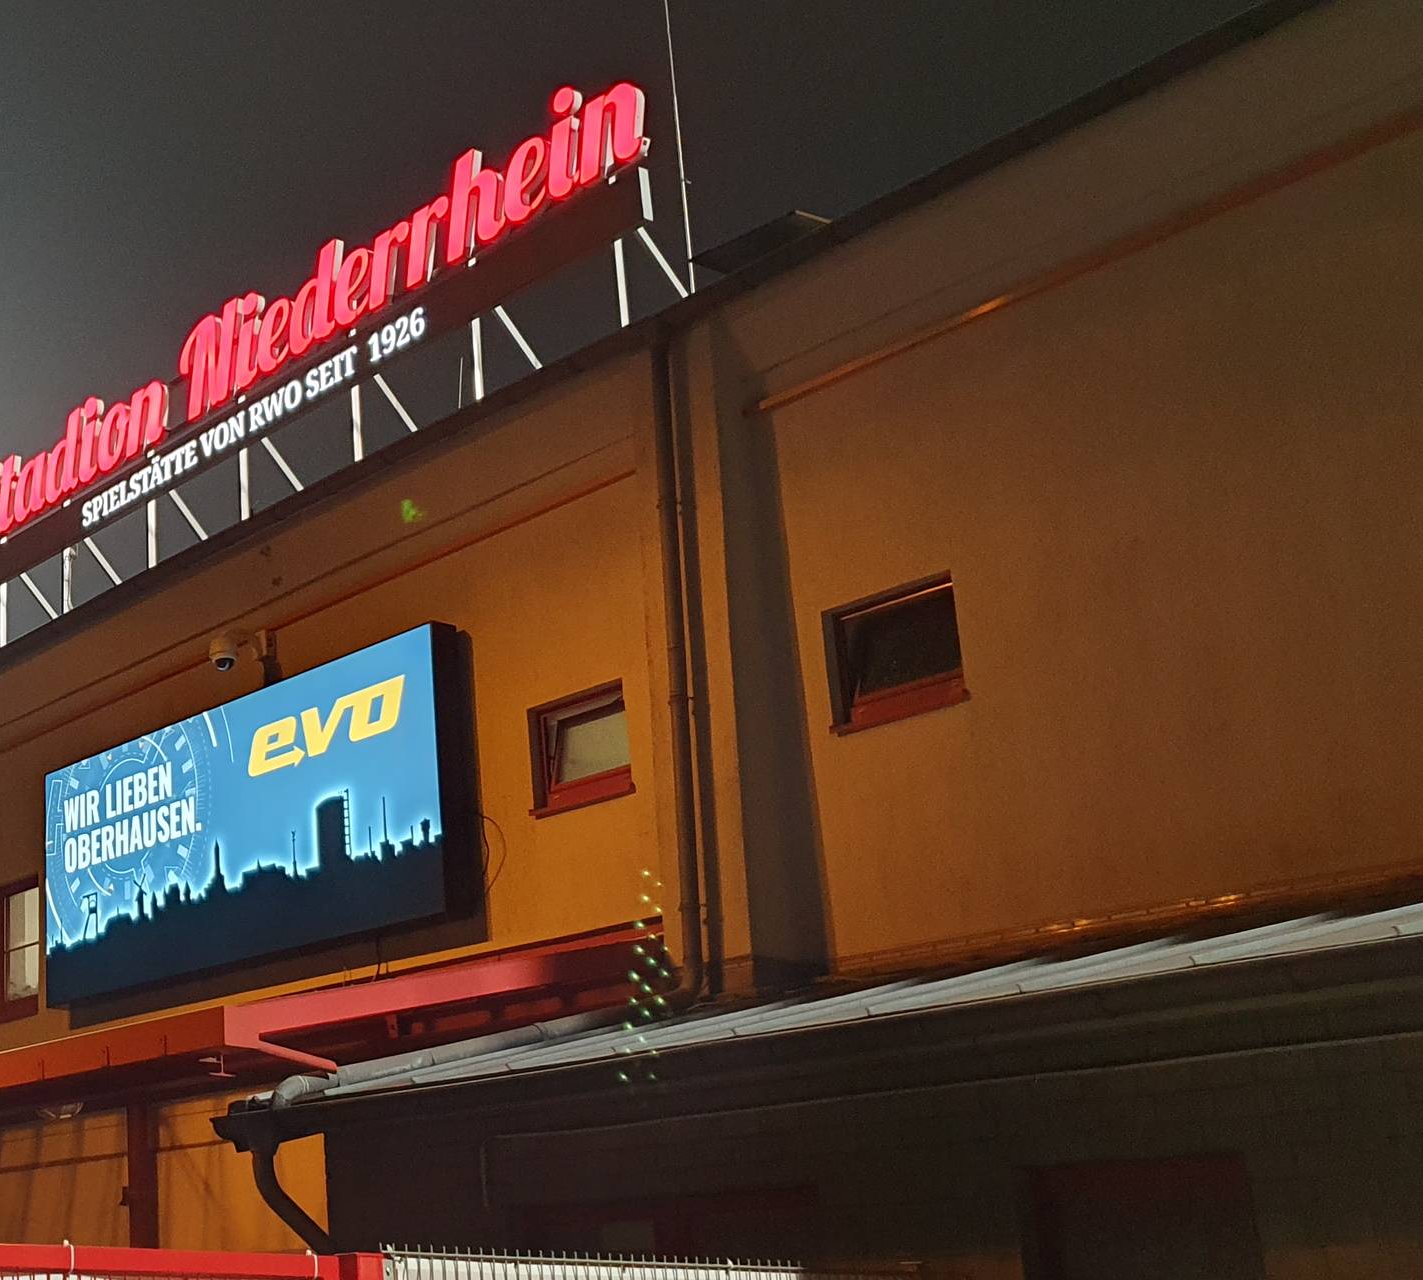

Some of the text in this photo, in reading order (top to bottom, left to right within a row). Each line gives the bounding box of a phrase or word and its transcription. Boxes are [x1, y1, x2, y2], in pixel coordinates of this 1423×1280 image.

[180, 82, 645, 421] Niederrhein
[82, 306, 425, 527] SPIELSTÄTTE VON RWO SEIT 1926
[248, 674, 405, 777] evo
[64, 761, 172, 833] WIR LIEBEN
[64, 796, 202, 873] OBERHAUSEN.
